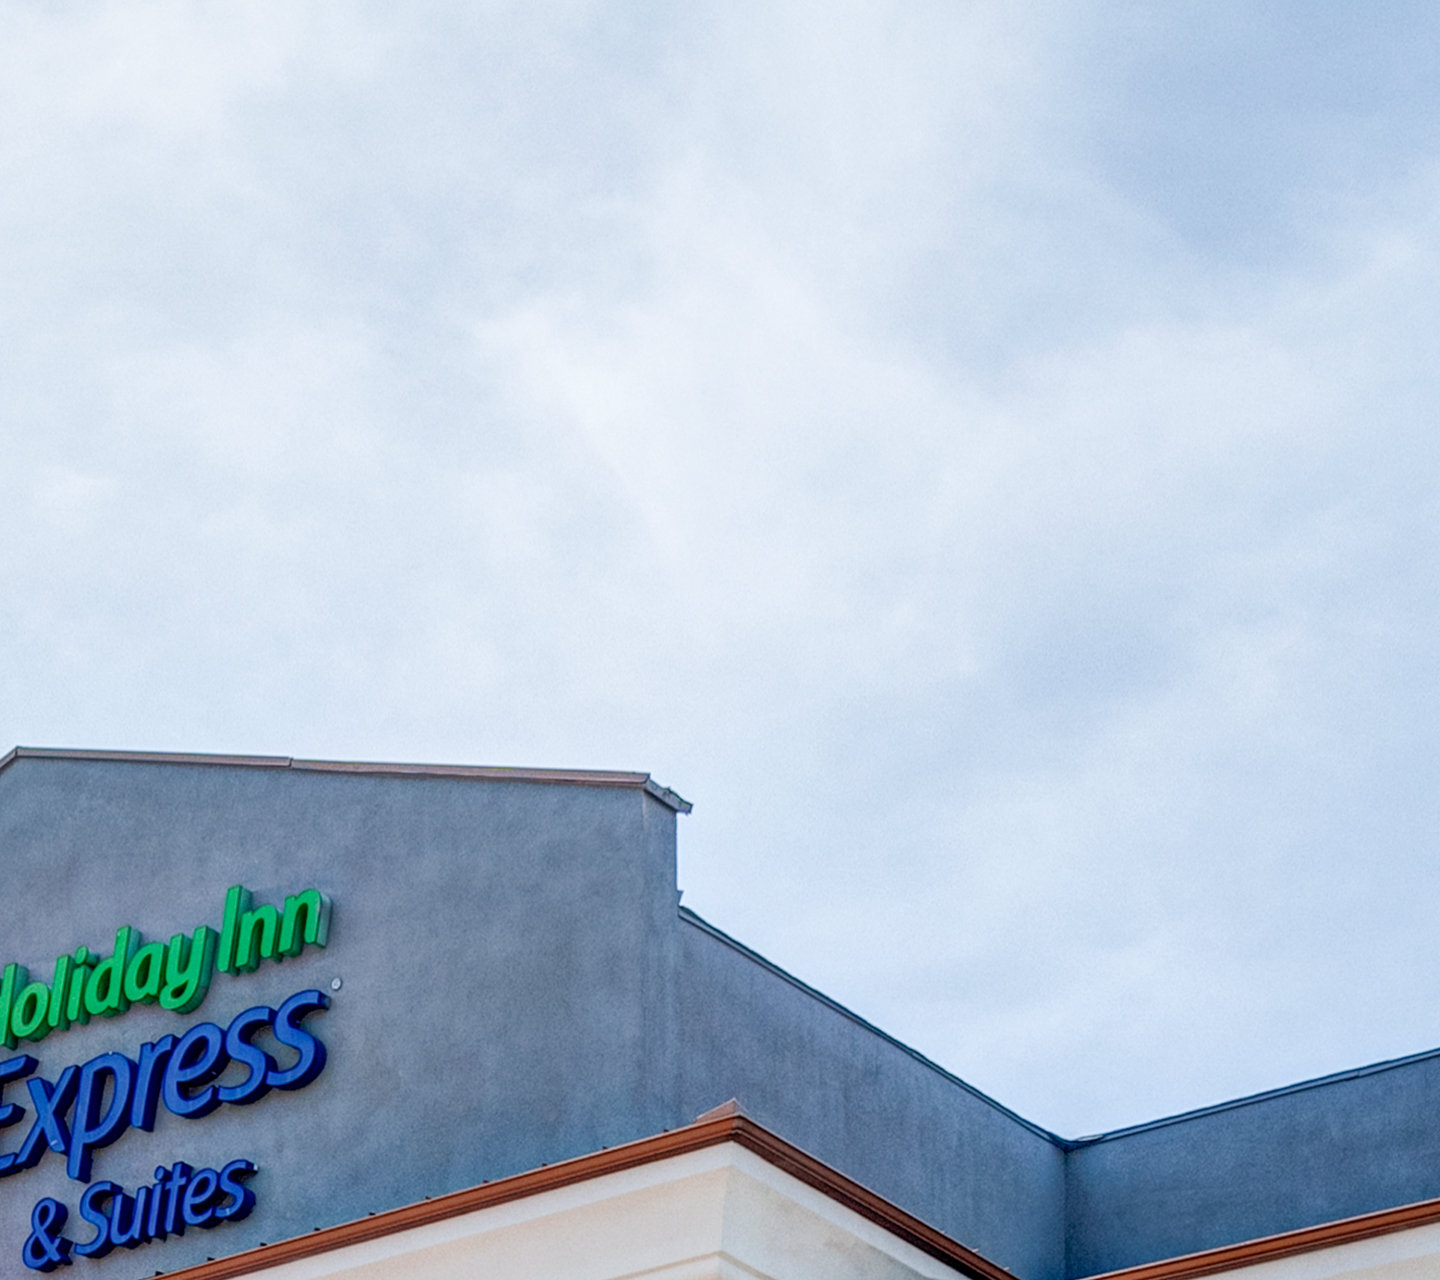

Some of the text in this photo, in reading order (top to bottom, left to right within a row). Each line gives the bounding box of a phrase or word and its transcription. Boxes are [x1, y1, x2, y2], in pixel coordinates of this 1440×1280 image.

[217, 884, 332, 975] Inn
[21, 1158, 258, 1273] & Suites
